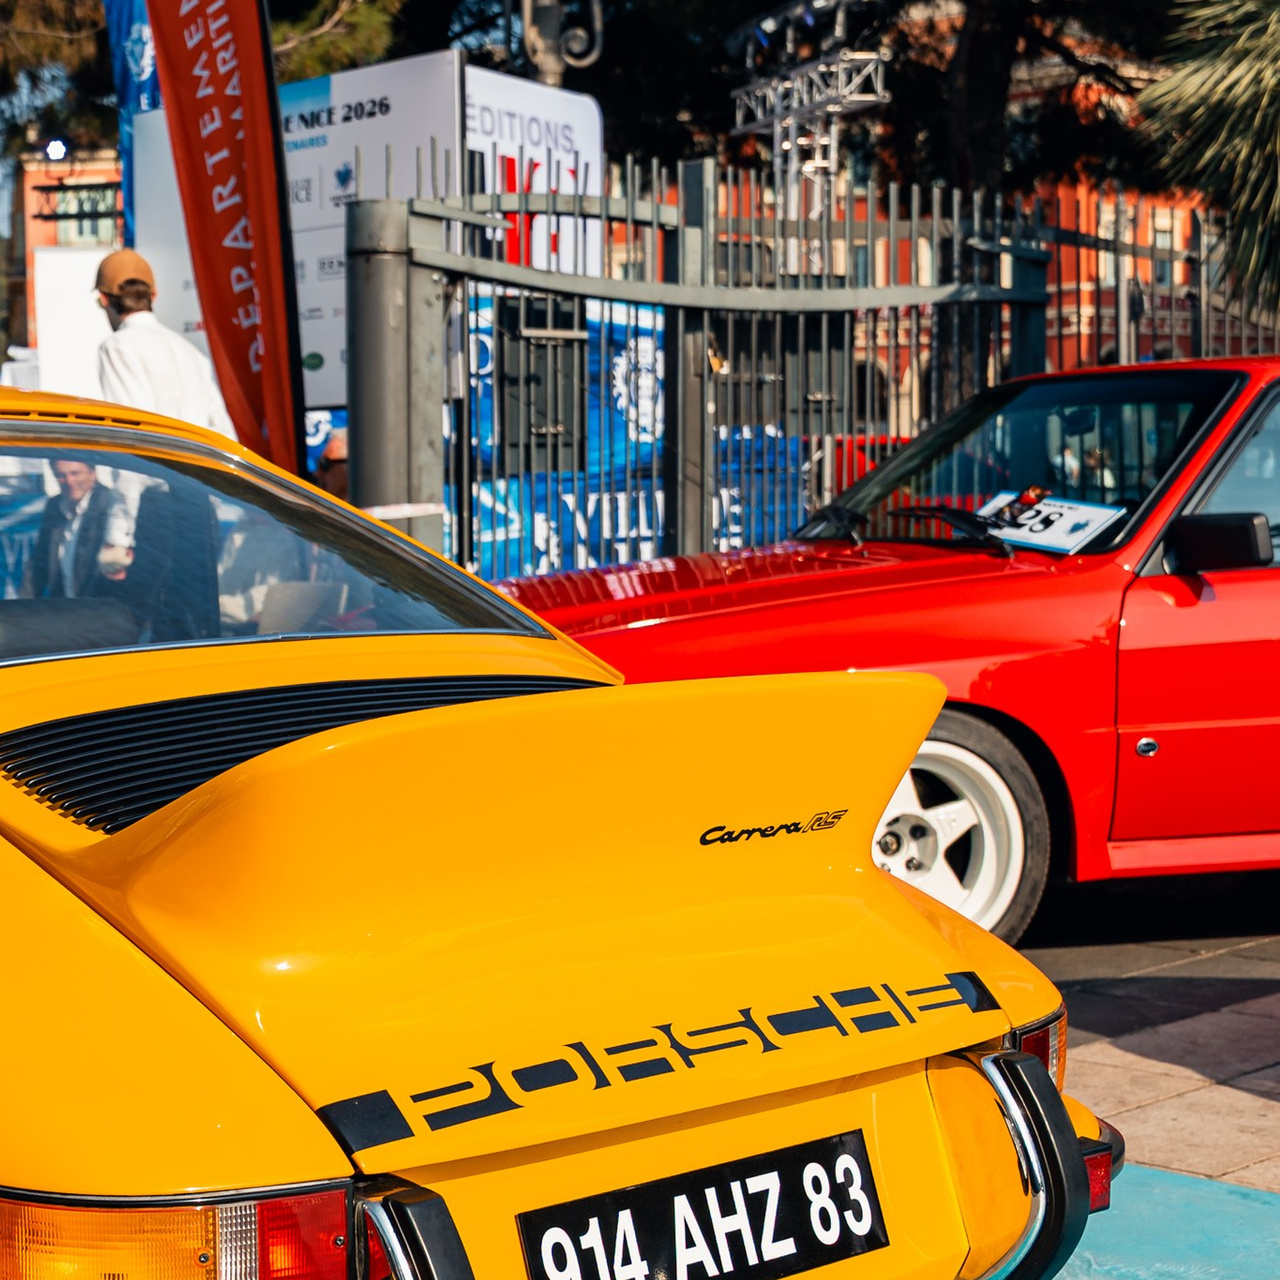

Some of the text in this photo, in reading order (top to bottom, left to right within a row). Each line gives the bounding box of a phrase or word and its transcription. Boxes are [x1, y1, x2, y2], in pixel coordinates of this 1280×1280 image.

[297, 106, 336, 131] NICE
[341, 97, 391, 123] 2026
[699, 808, 849, 846] Carrera RS
[365, 972, 982, 1142] PORSCHE
[801, 1153, 874, 1248] 83
